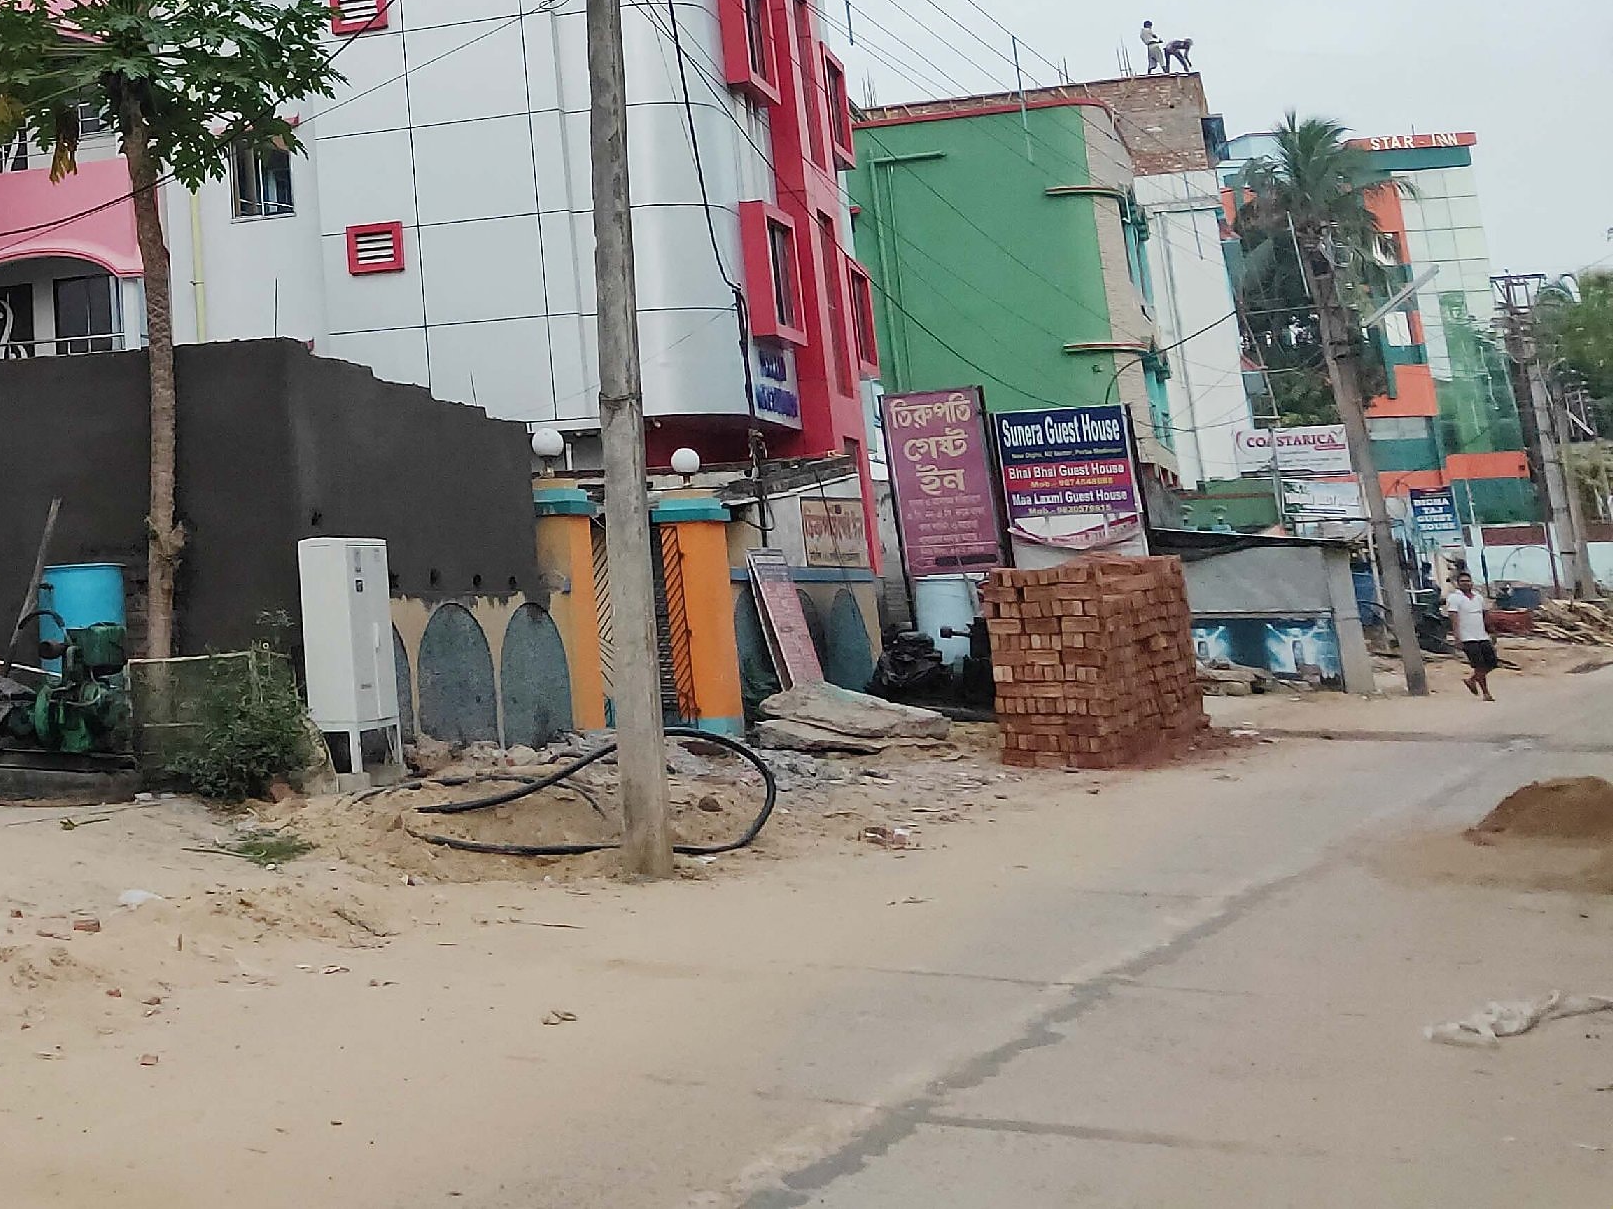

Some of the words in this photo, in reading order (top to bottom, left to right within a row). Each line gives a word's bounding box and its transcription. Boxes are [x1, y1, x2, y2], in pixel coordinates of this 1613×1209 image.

[1370, 135, 1415, 150] STAR
[890, 392, 970, 429] তিরুপতি
[1002, 419, 1044, 447] Sunera
[1045, 415, 1080, 445] Guest
[1081, 413, 1120, 442] House
[915, 464, 965, 495] ইন
[1058, 464, 1090, 477] Guest
[1091, 462, 1125, 475] House
[1011, 494, 1033, 506] Maa
[1034, 491, 1063, 505] Laxmi
[1065, 490, 1096, 503] Guest
[1096, 489, 1128, 501] House
